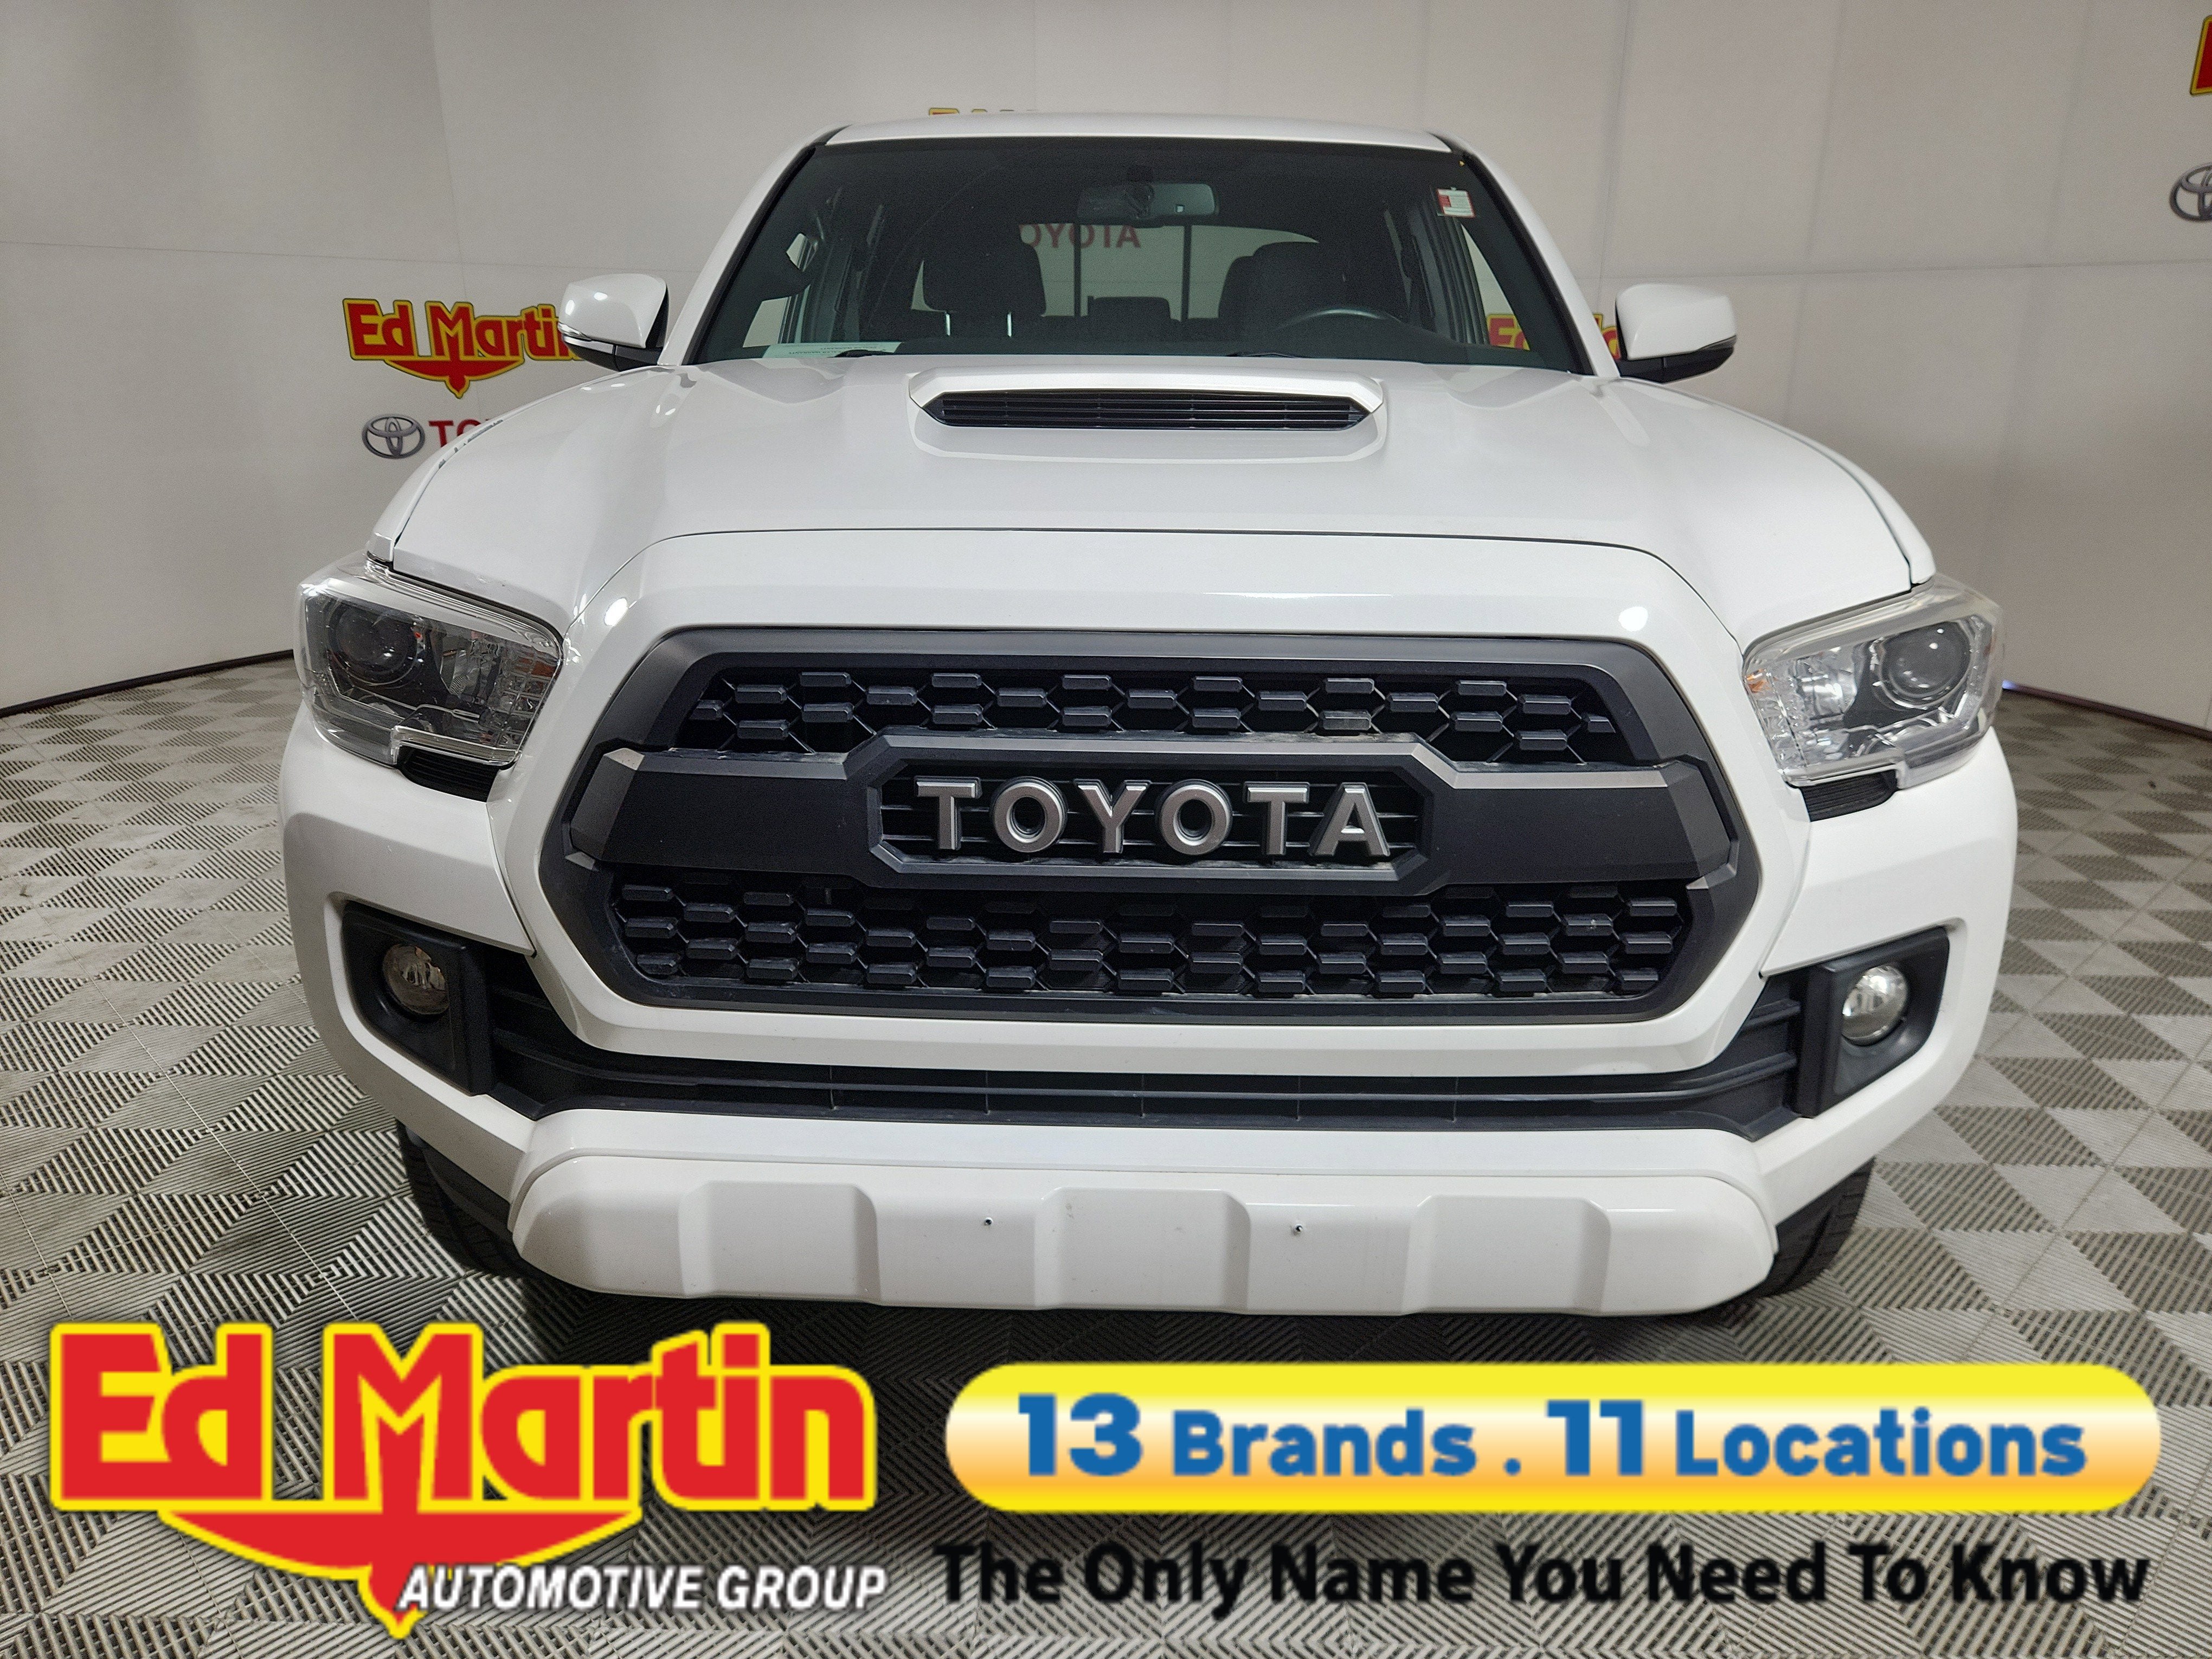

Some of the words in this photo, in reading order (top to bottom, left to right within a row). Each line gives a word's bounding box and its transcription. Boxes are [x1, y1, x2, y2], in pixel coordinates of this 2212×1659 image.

[1018, 223, 1140, 248] OYOTA
[342, 298, 419, 360] Ed
[912, 776, 1390, 857] TOYOTA
